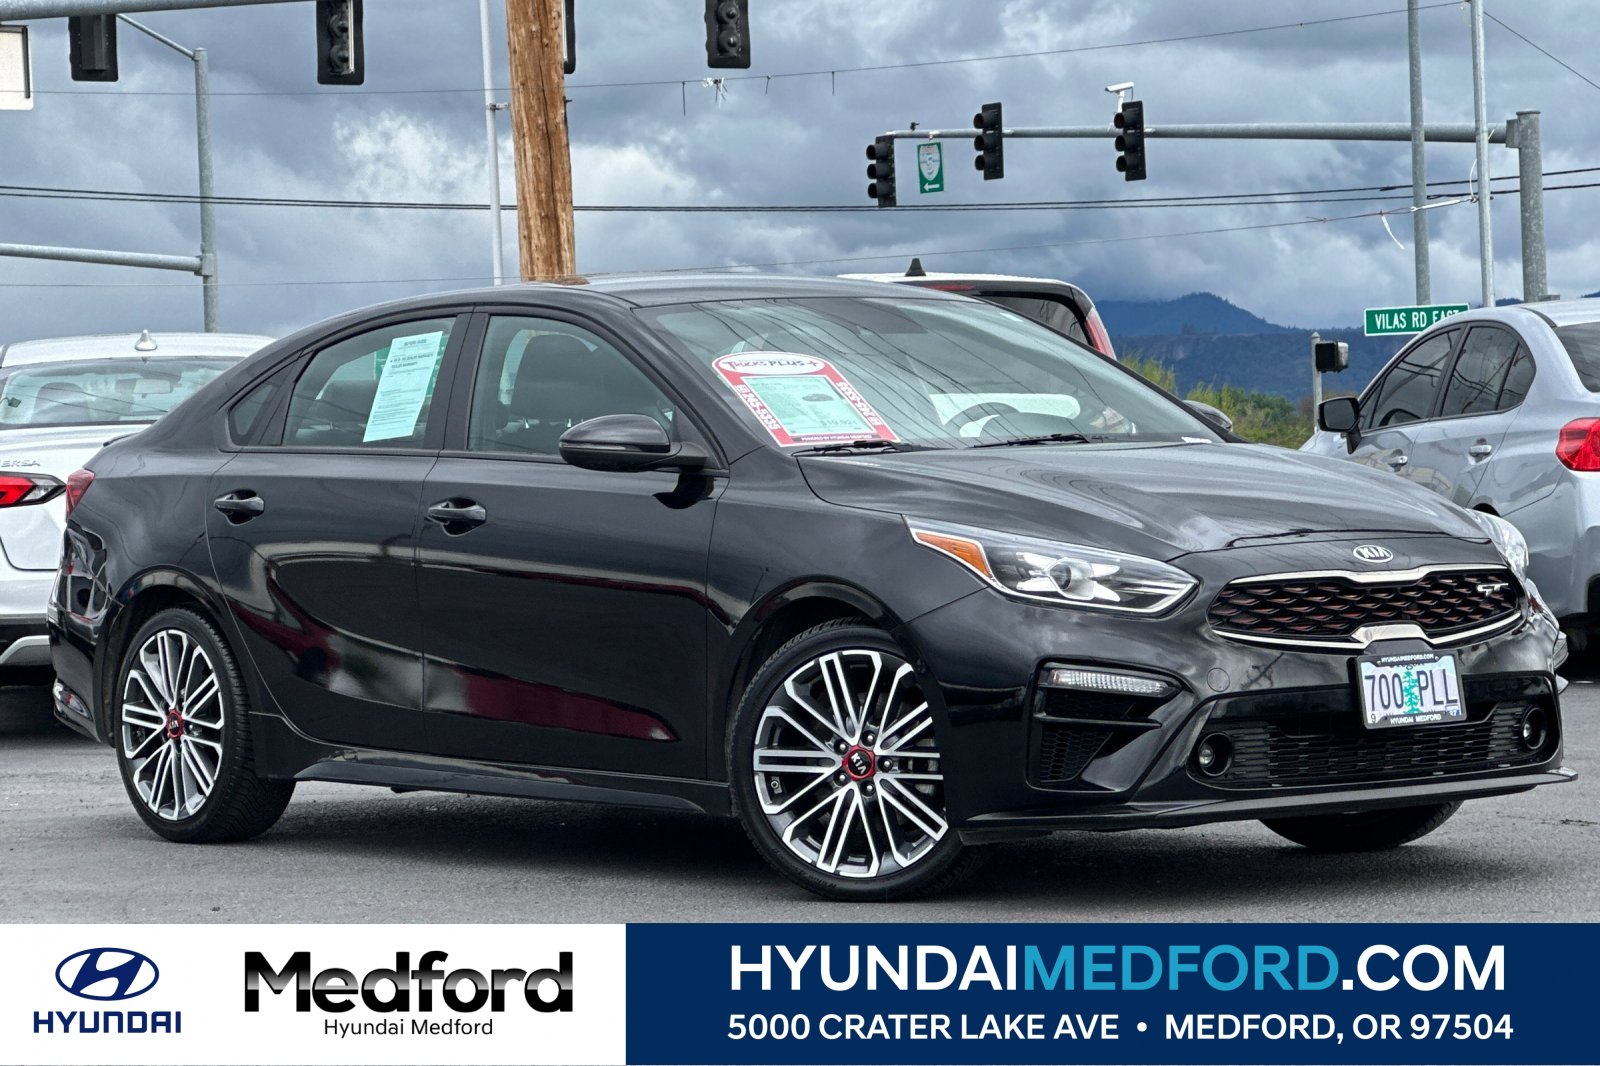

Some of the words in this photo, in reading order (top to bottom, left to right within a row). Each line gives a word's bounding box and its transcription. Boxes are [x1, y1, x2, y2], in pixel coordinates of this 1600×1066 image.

[1374, 312, 1407, 329] VILAS
[1412, 310, 1427, 328] RD
[1432, 309, 1460, 324] EA
[1361, 546, 1390, 558] KIA
[1381, 653, 1434, 663] HYUNDAIMEDFORD.COM
[1364, 673, 1405, 711] 700
[1416, 668, 1458, 706] PLL
[1391, 716, 1414, 725] HYUNDAI
[1416, 713, 1442, 722] MEDFORD
[851, 752, 867, 775] KIA
